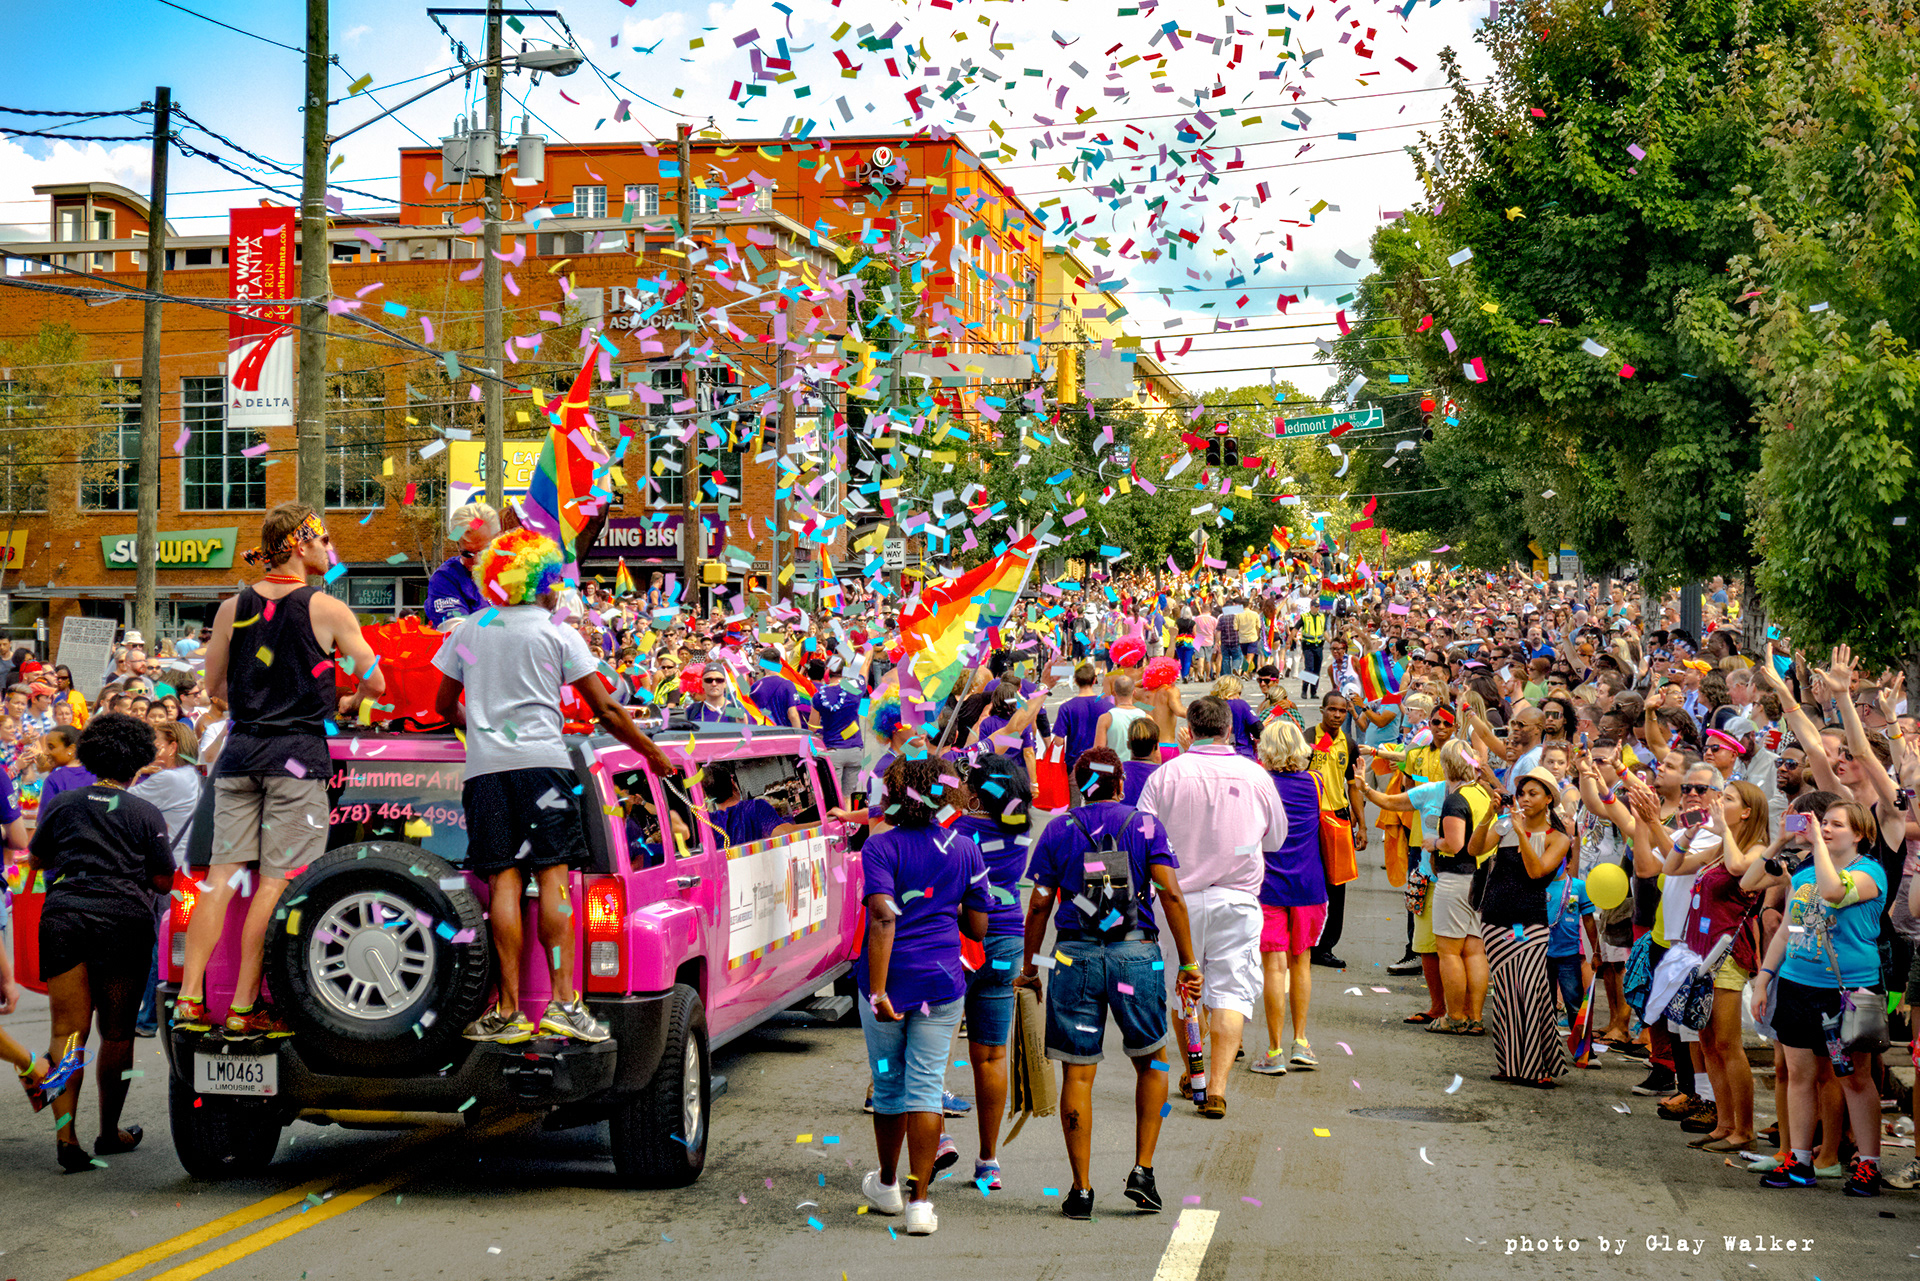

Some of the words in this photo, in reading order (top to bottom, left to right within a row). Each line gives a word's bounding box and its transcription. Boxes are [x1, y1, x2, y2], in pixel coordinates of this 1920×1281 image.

[236, 235, 249, 280] WALK
[264, 263, 274, 288] RUN
[277, 223, 287, 320] adwalkatlanta.com
[245, 398, 290, 408] DELTA
[1284, 419, 1327, 434] iedmont
[885, 550, 901, 558] WAY
[362, 589, 393, 598] FLYING
[358, 597, 392, 605] BISCUIT
[377, 802, 467, 830] 464-4996
[215, 1083, 256, 1092] LIMOUSINE
